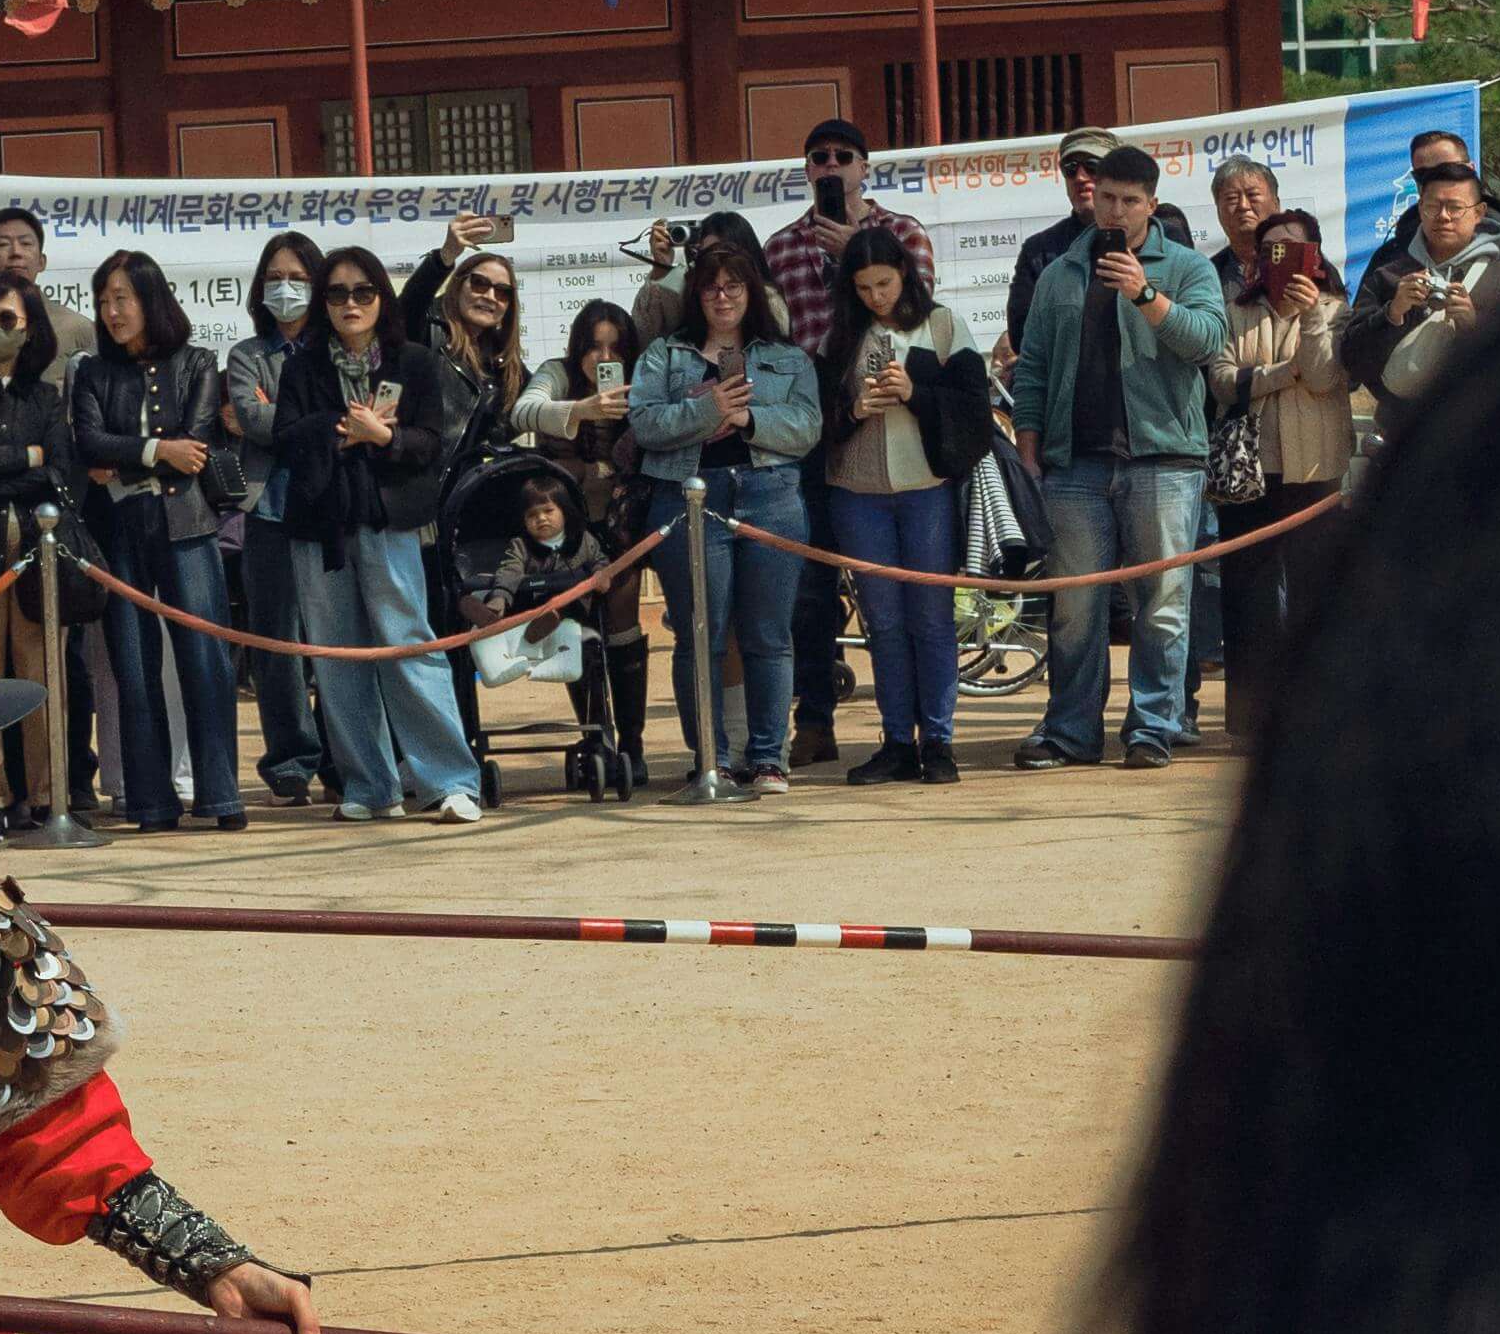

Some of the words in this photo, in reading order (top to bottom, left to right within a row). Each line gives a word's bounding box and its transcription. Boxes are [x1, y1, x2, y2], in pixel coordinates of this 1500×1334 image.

[117, 190, 293, 236] 세계문화유산
[299, 187, 360, 227] 화성
[365, 186, 425, 224] 운영
[510, 181, 540, 216] 및
[542, 176, 658, 215] 시행규칙
[662, 170, 752, 208] 개정에
[753, 167, 807, 202] 따른
[1262, 123, 1315, 168] 안내
[557, 274, 595, 289] 1,500원
[971, 272, 1009, 287] 3,500원
[560, 299, 588, 312] 1,200
